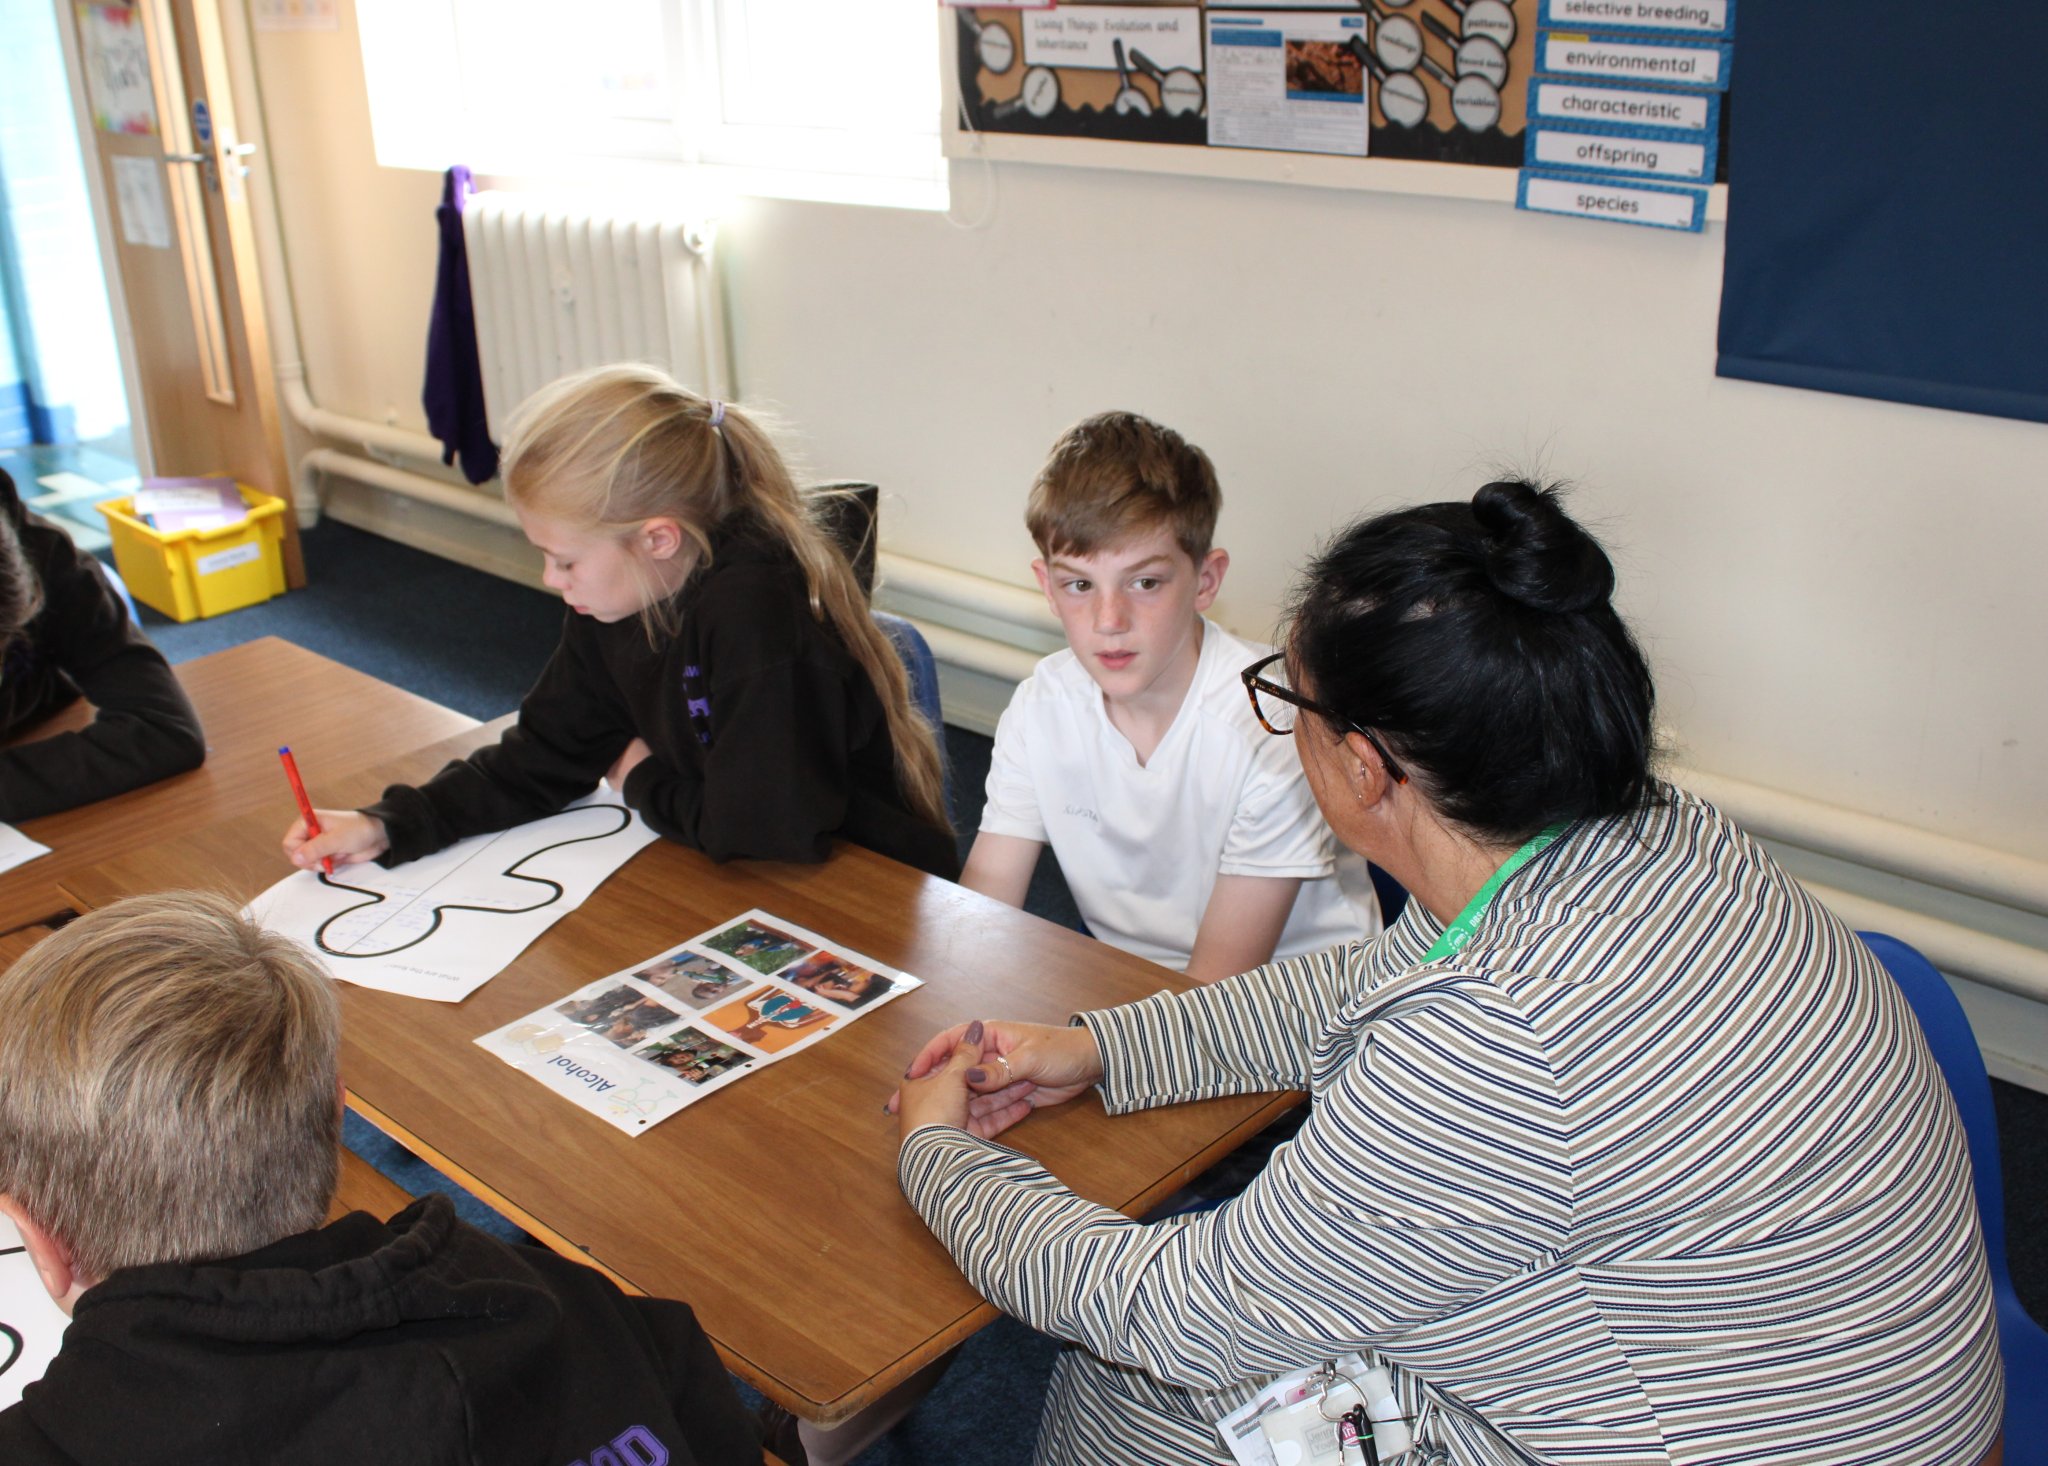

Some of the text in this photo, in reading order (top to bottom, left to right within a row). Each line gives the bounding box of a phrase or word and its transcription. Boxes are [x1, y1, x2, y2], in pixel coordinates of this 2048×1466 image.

[1157, 18, 1179, 32] and
[1565, 0, 1709, 25] selective breeding
[1565, 50, 1696, 73] environmental
[1561, 94, 1681, 120] characteristic
[1576, 143, 1658, 169] offspring
[1576, 194, 1639, 213] species
[546, 1054, 617, 1092] Alcohol
